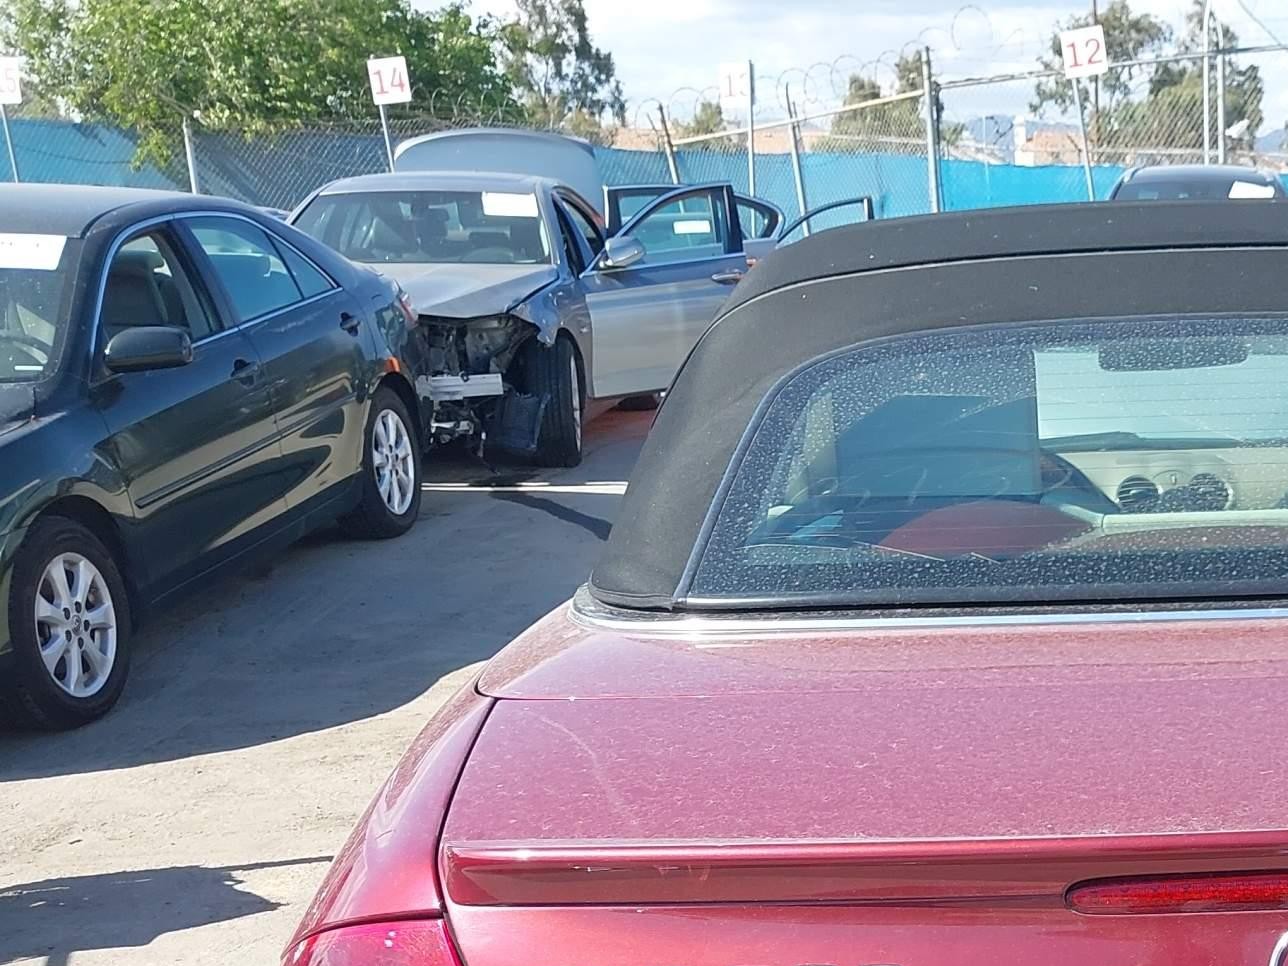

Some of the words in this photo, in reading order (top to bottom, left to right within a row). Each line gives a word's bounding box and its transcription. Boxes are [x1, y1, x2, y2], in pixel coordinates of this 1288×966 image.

[1066, 38, 1102, 67] 12
[0, 68, 16, 93] 5
[373, 67, 404, 95] 14
